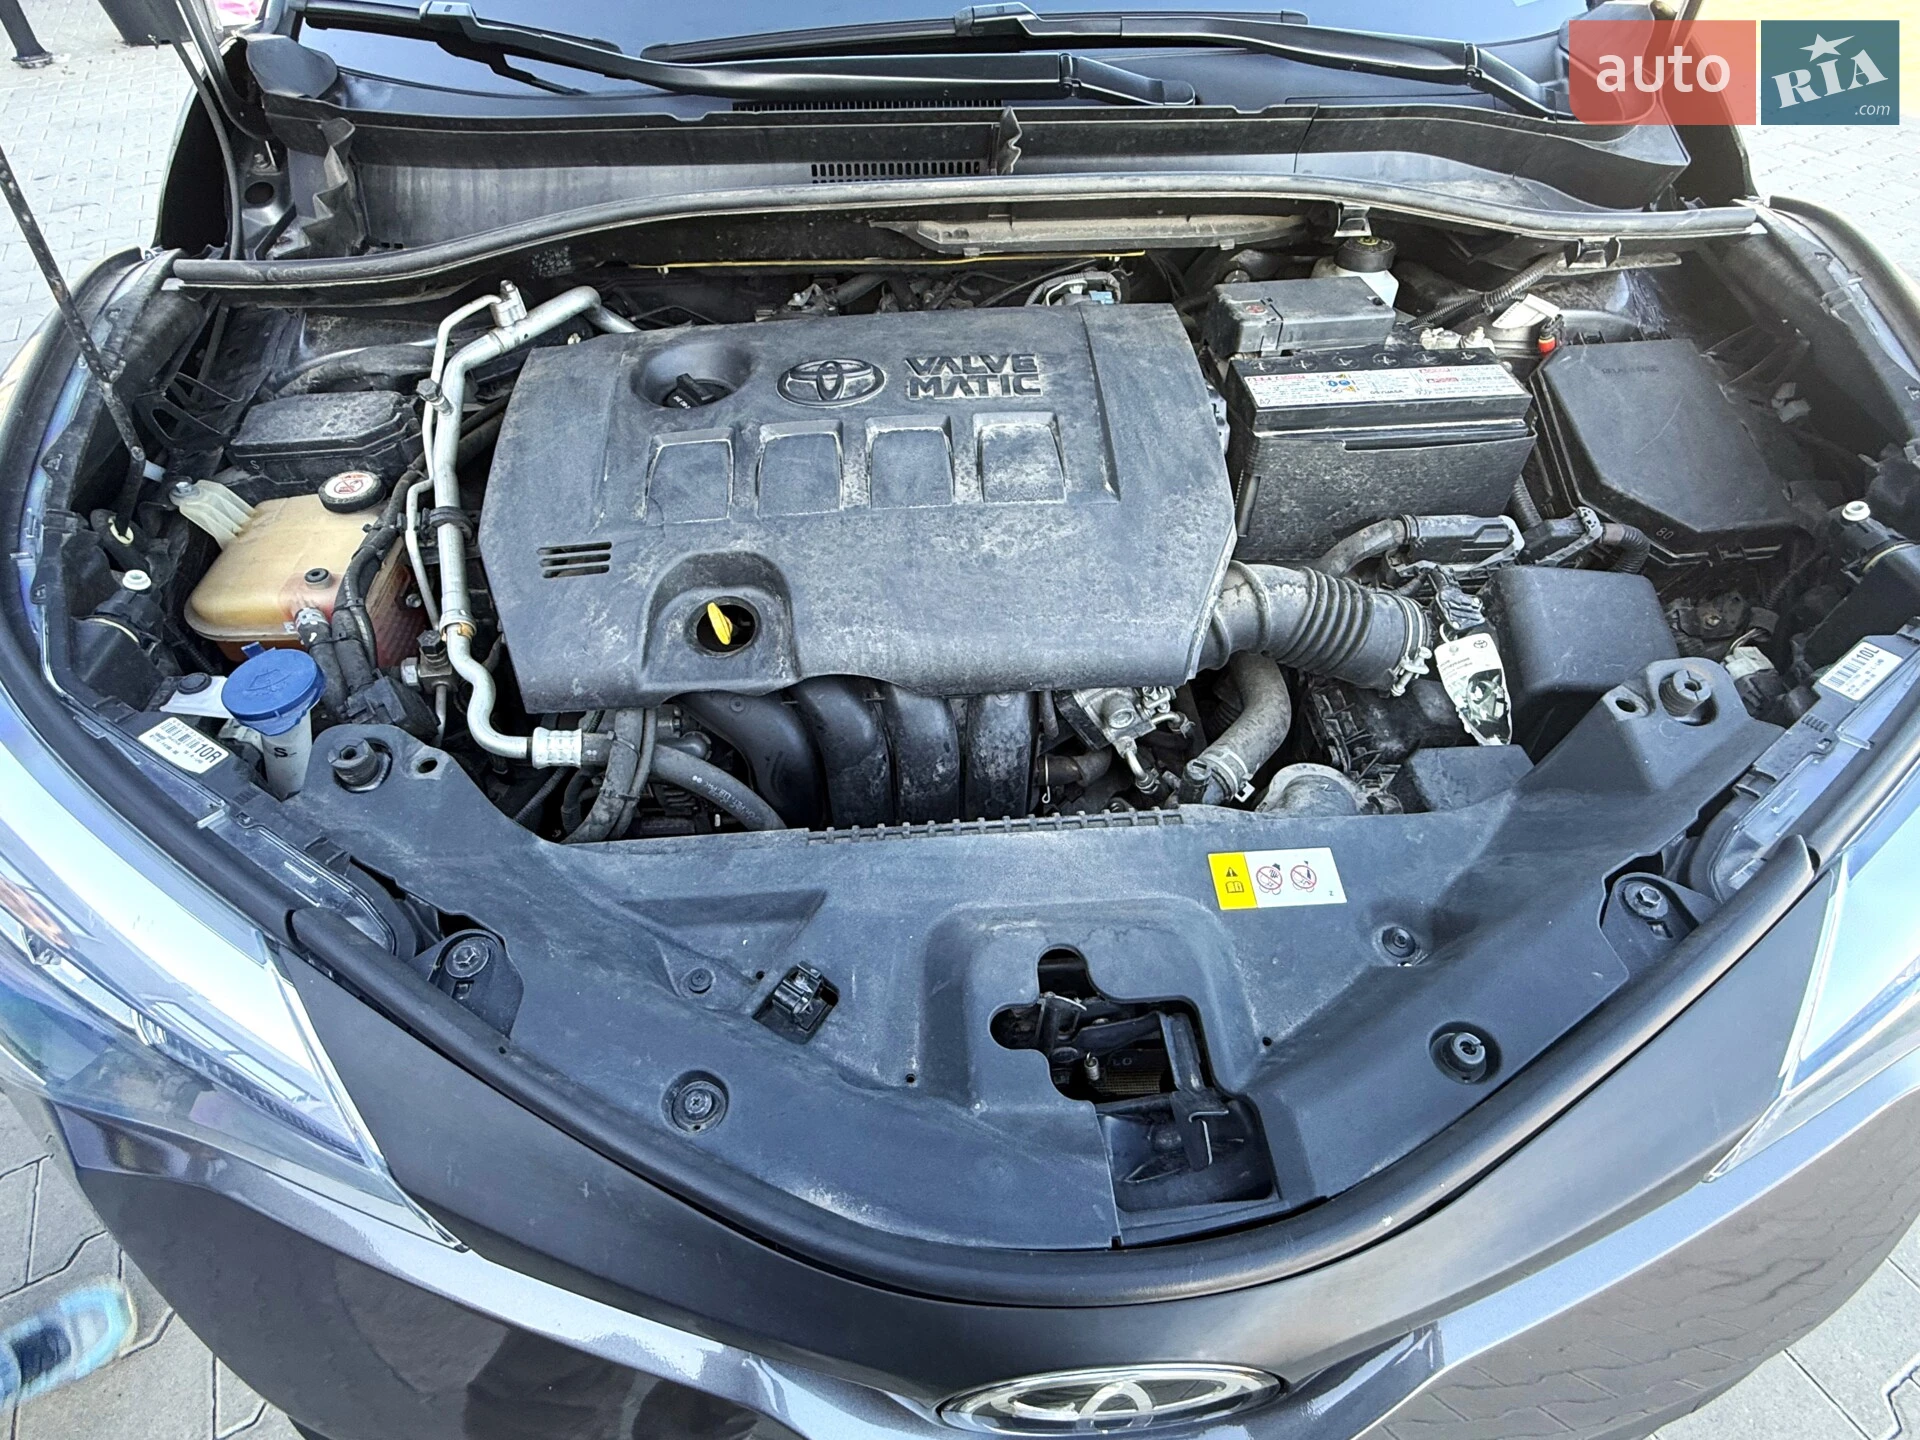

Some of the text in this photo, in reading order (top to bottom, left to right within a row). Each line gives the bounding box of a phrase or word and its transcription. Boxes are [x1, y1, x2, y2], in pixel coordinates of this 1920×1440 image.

[905, 353, 1039, 386] VALVE
[908, 373, 1043, 400] MATIC
[1856, 646, 1880, 661] 10L
[194, 743, 222, 763] 10R
